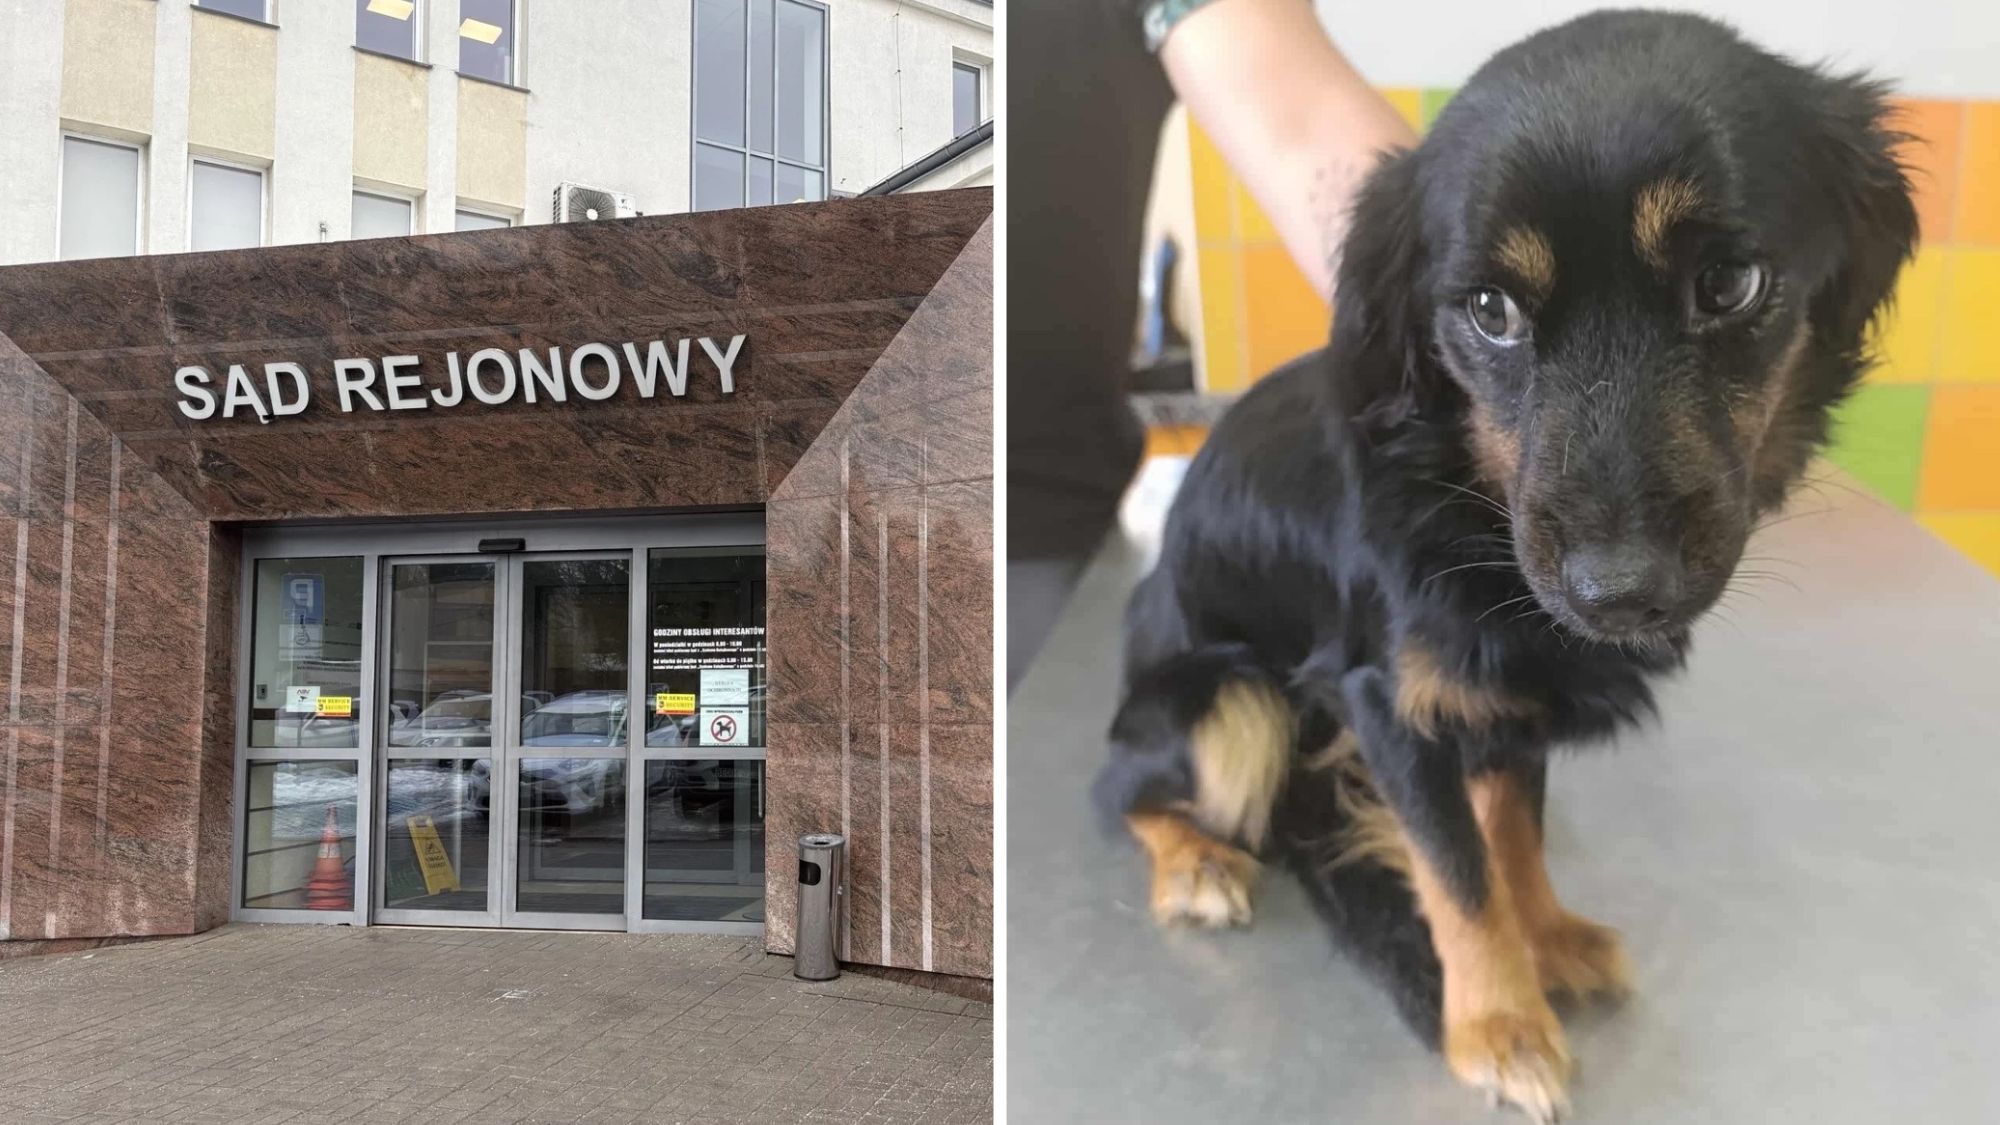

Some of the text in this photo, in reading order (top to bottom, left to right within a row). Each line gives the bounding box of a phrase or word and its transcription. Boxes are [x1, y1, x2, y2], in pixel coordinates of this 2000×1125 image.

[174, 333, 748, 424] SĄD REJONOWY
[653, 626, 765, 636] GODZINY OBSŁUGI INTERESANTÓW
